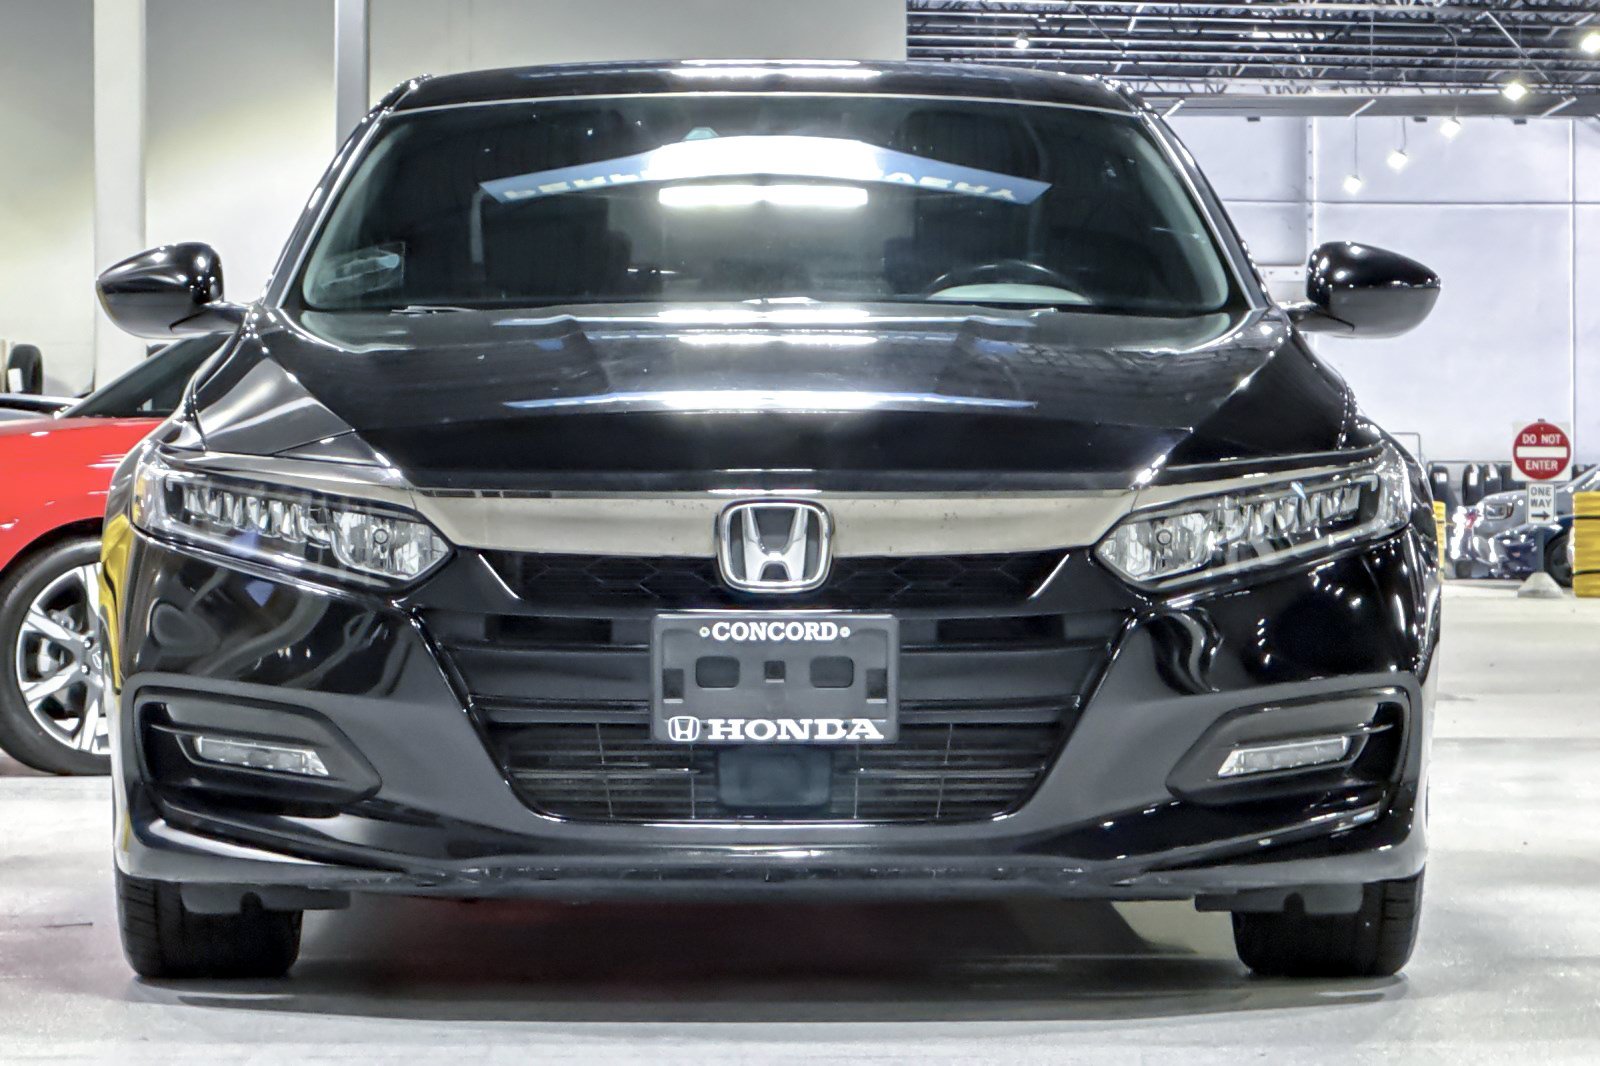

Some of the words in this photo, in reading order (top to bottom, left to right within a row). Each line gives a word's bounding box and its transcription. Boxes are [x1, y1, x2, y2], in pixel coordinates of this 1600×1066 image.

[1522, 434, 1537, 444] DO
[1541, 434, 1561, 444] NOT
[1525, 460, 1558, 471] ENTER
[1530, 486, 1551, 496] ONE
[1530, 499, 1552, 508] WAY
[711, 621, 838, 641] CONCORD
[707, 718, 884, 740] HONDA
